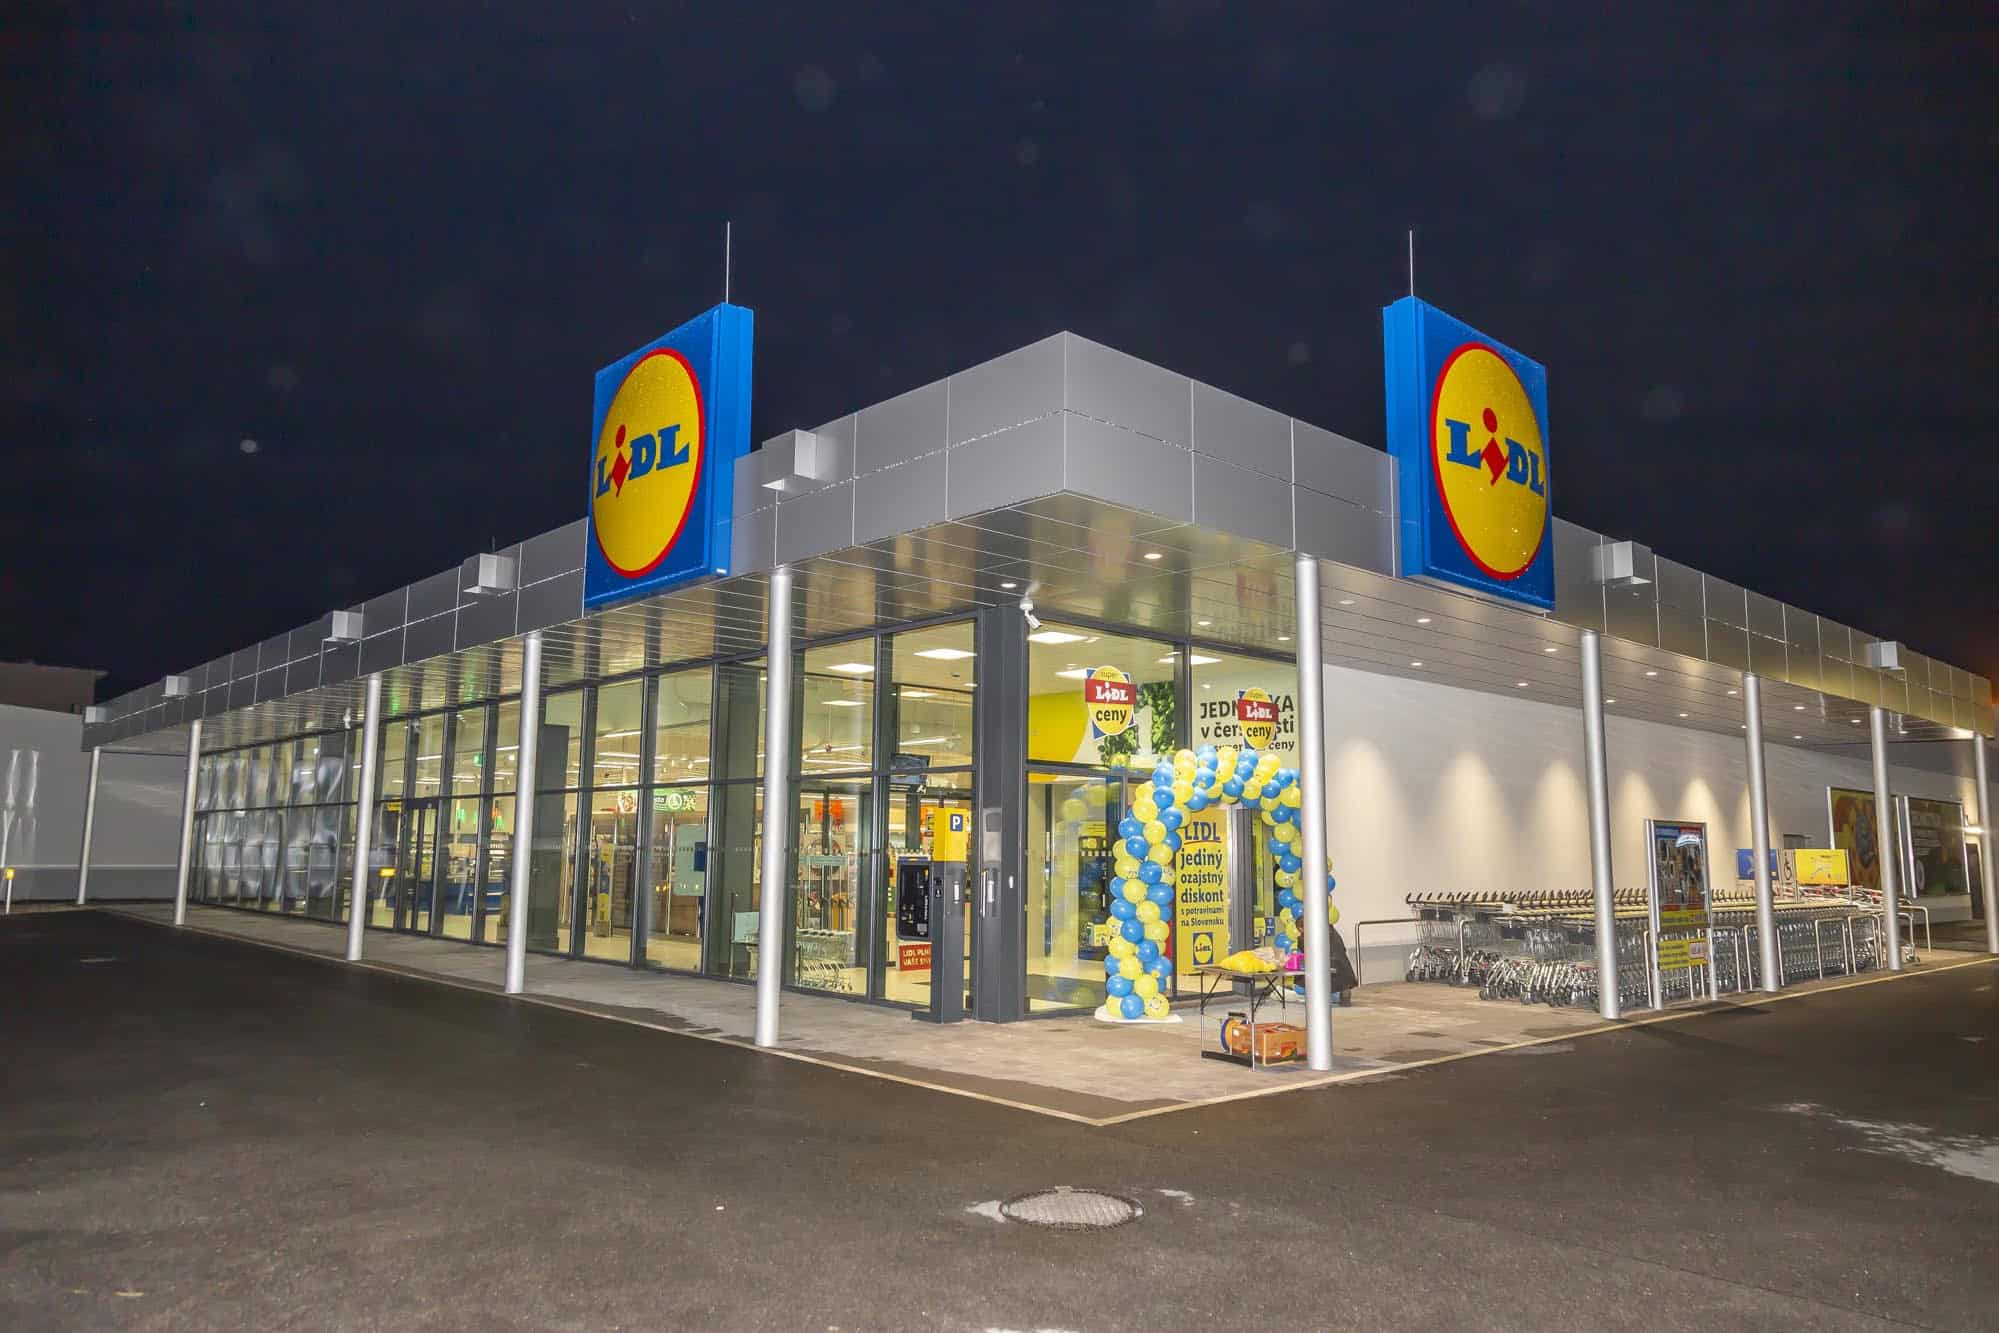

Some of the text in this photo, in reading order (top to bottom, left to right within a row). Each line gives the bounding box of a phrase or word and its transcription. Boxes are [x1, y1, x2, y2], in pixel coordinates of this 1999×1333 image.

[1095, 709, 1127, 724] ceny
[1246, 726, 1271, 740] ceny
[1268, 741, 1295, 751] ceny
[952, 815, 961, 830] P
[1184, 821, 1220, 841] LIDL
[1181, 848, 1222, 870] jediný
[1181, 870, 1223, 886] ozajstný
[1181, 888, 1223, 903] diskont
